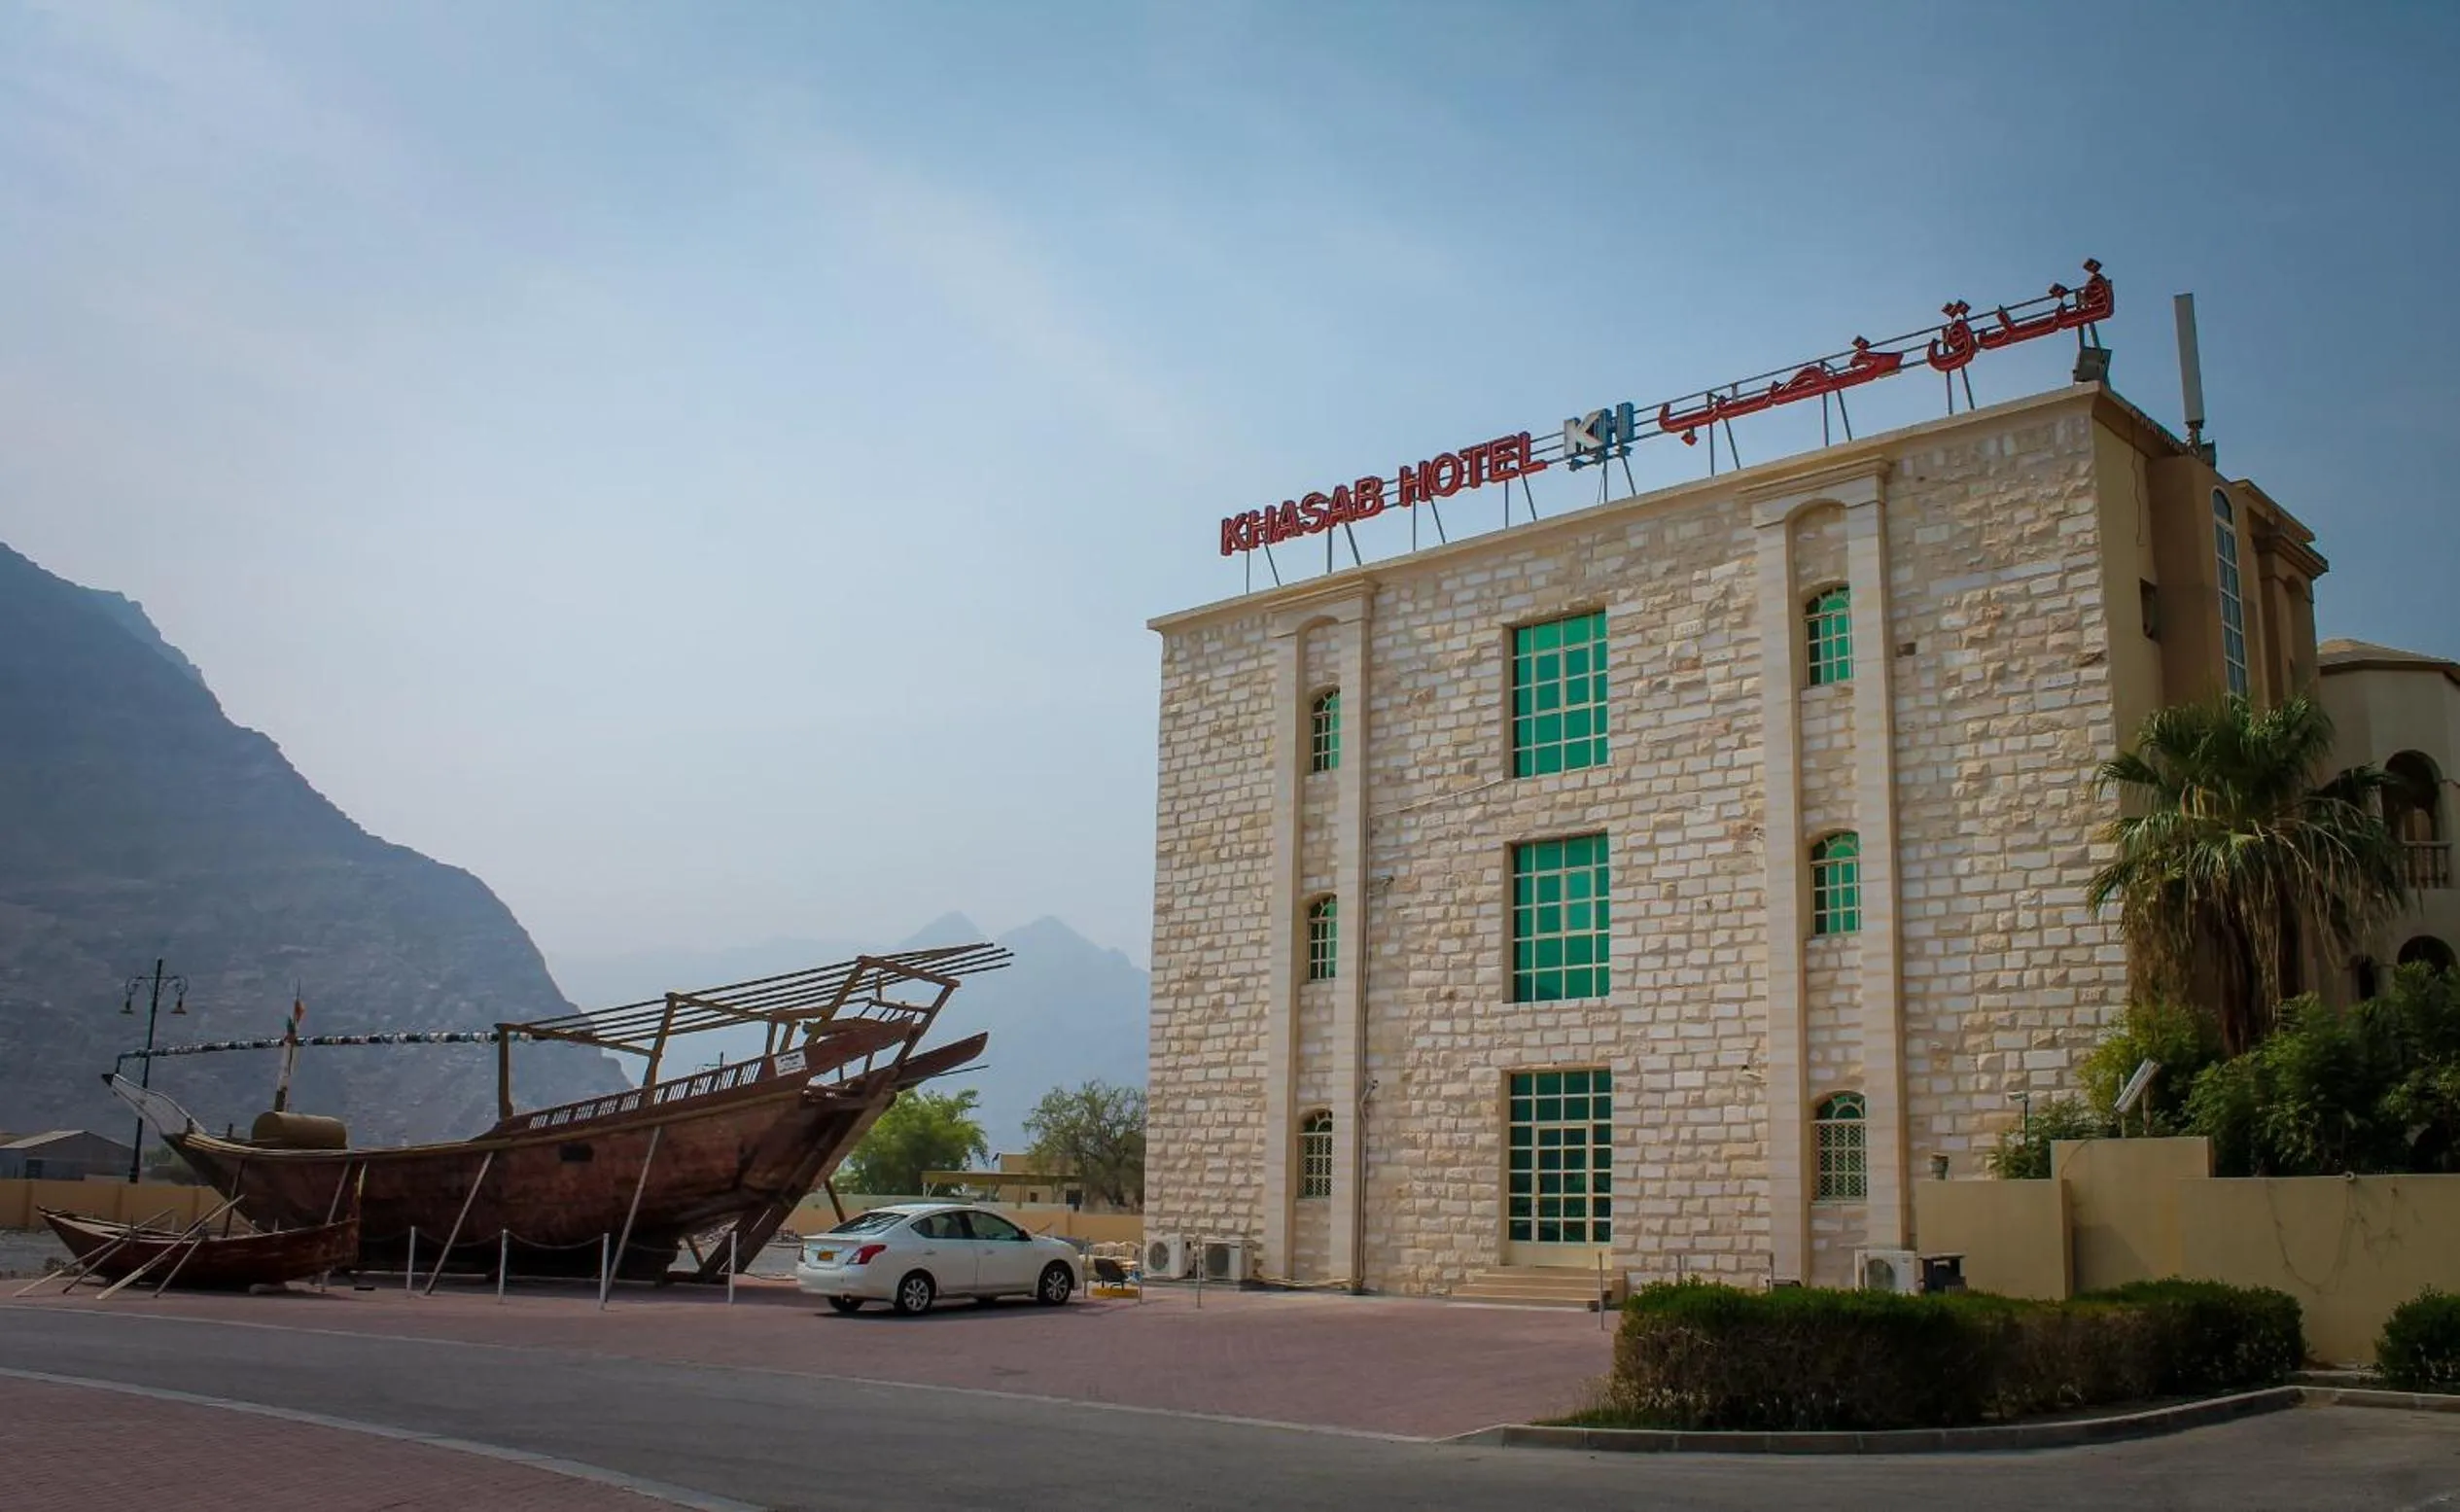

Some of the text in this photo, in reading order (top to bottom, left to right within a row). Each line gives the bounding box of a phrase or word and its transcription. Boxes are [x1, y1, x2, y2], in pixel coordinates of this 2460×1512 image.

[1658, 258, 2115, 446] فندق خصب
[1220, 431, 1548, 556] KHASAB HOTEL
